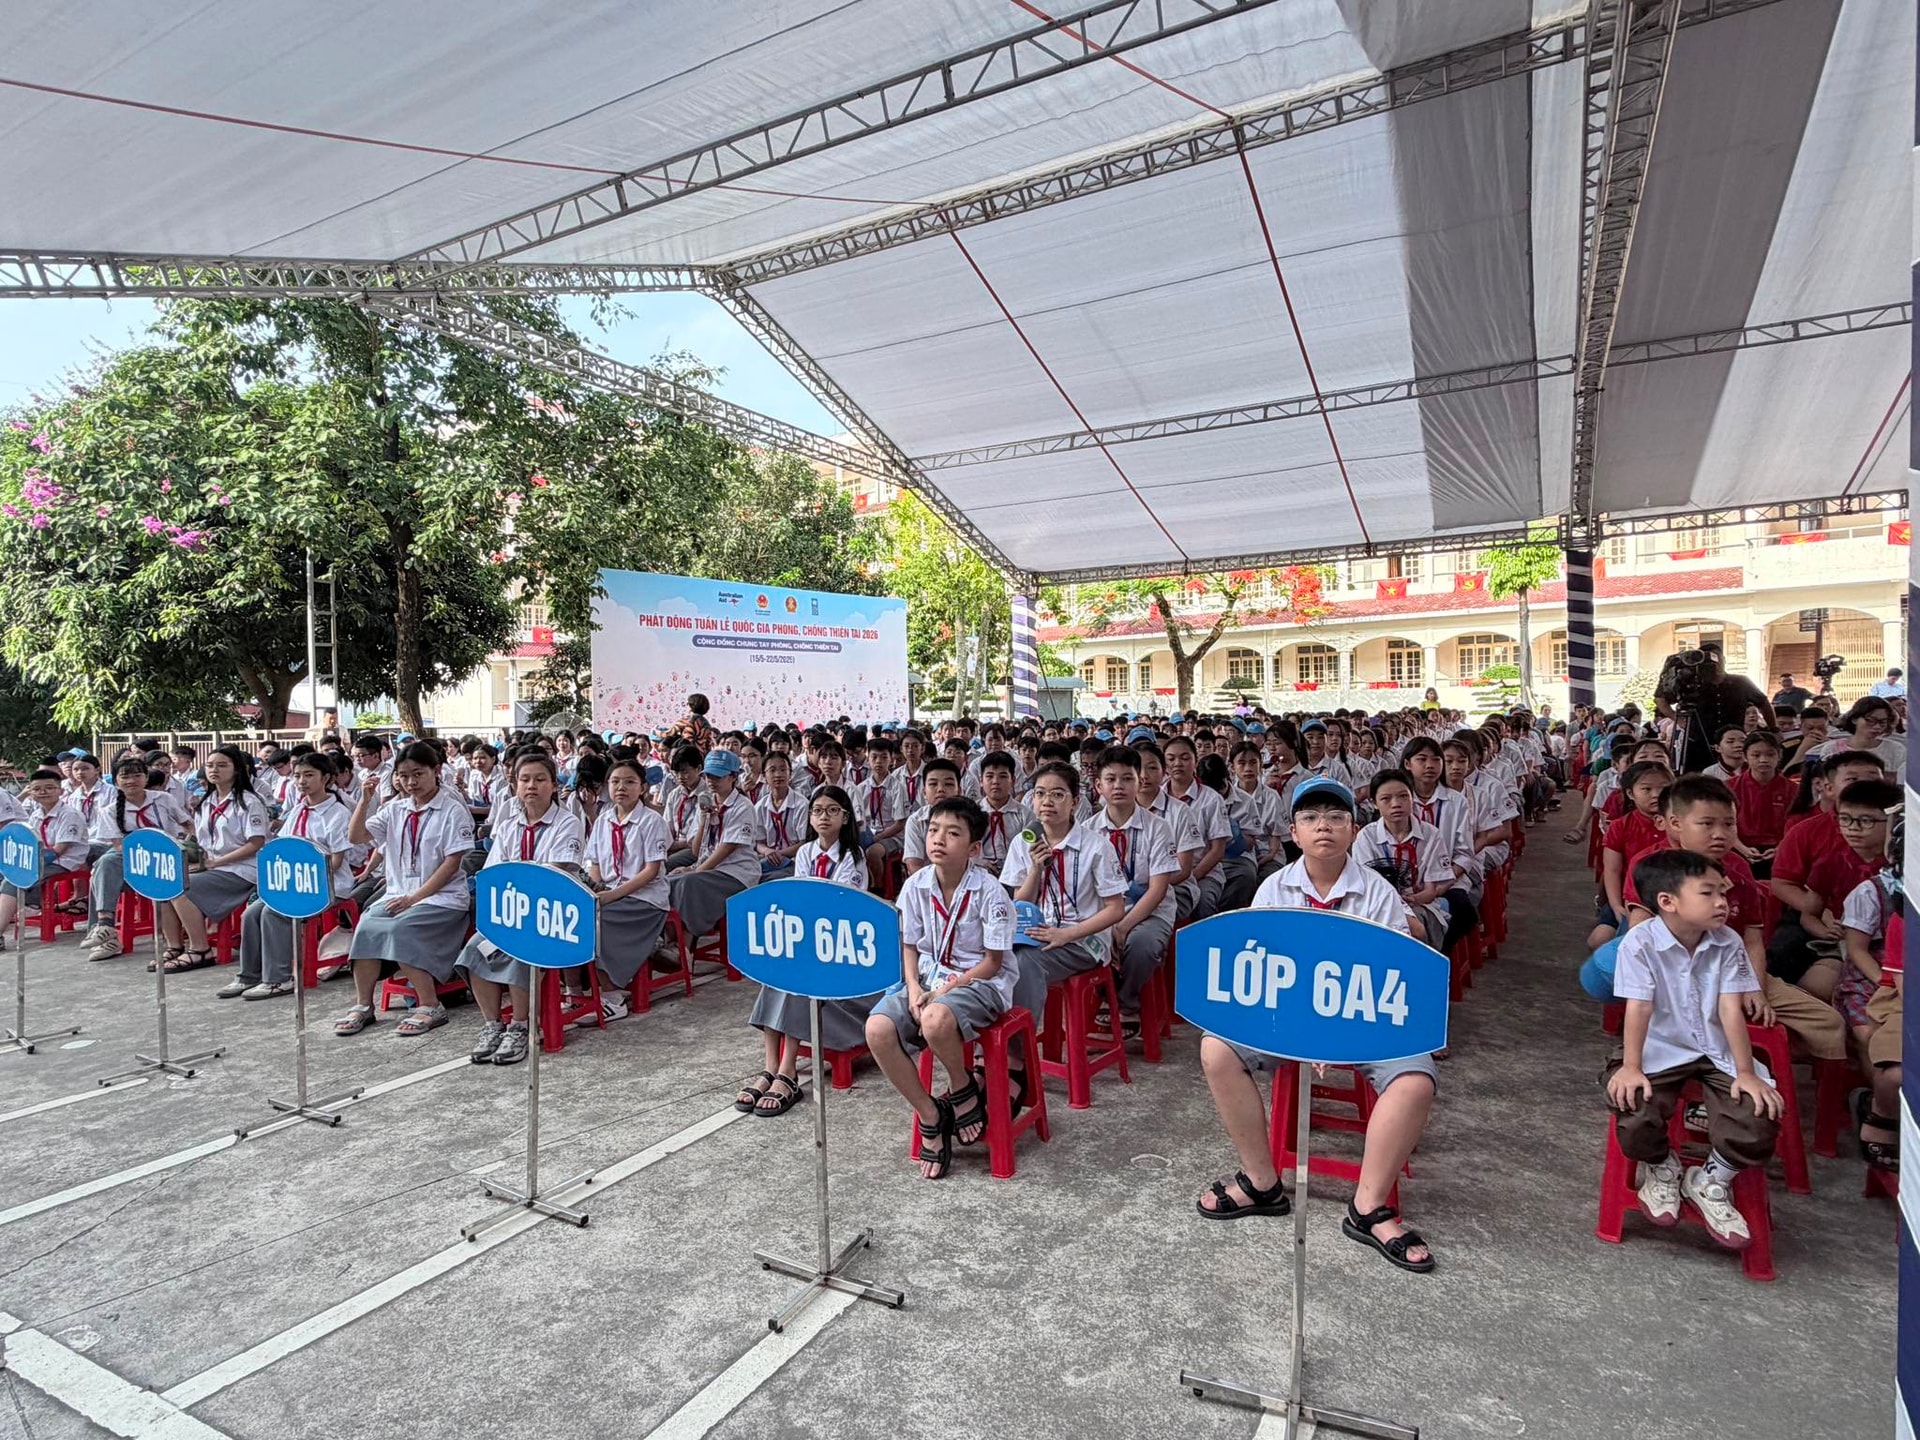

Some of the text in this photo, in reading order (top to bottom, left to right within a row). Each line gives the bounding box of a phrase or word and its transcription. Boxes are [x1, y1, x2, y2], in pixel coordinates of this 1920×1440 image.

[639, 613, 664, 627] PHÁT
[666, 614, 692, 630] ĐỘNG
[756, 622, 770, 633] GIA
[851, 628, 861, 639] TAI
[696, 637, 716, 646] CỘNG
[736, 640, 758, 648] CHUNG
[3, 840, 34, 872] LỚP 7A7
[128, 842, 176, 882] LỚP 7A8
[266, 855, 319, 894] LỚP 6A1
[489, 881, 580, 944] LỚP 6A2
[747, 903, 877, 967] LỚP 6A3
[1206, 938, 1409, 1027] LỚP 6A4
